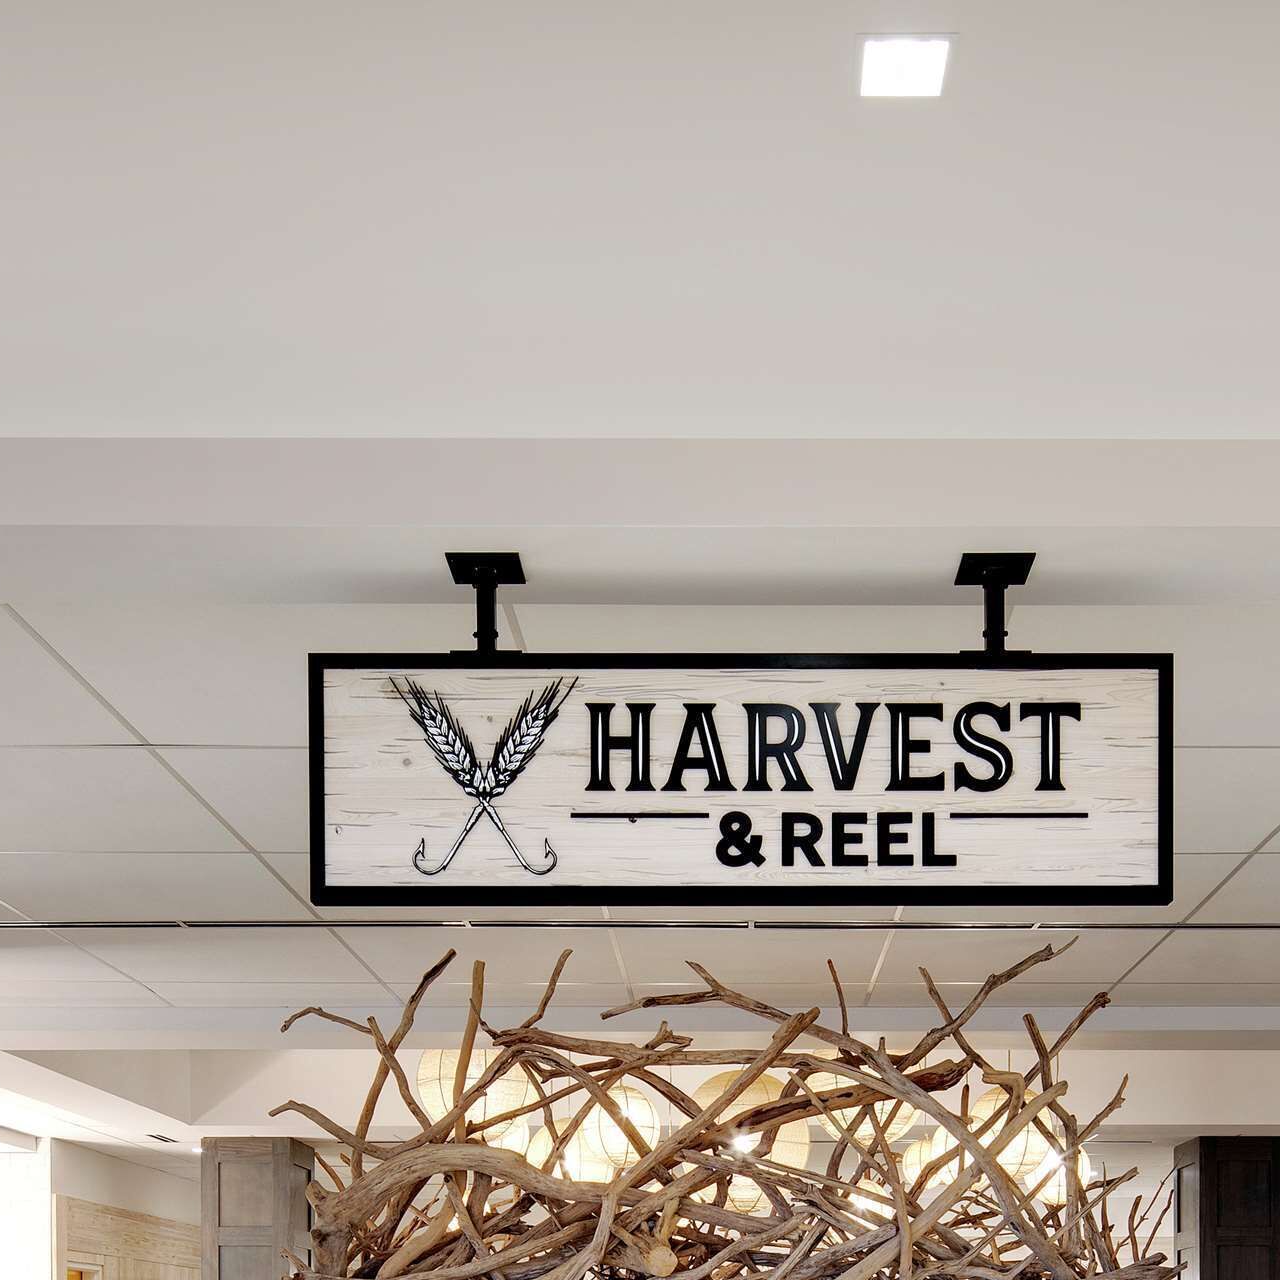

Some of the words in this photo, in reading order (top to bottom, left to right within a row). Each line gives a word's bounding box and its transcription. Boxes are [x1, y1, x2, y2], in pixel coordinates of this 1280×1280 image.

[584, 702, 1082, 792] HARVEST
[716, 810, 766, 867] &
[782, 811, 957, 867] REEL
